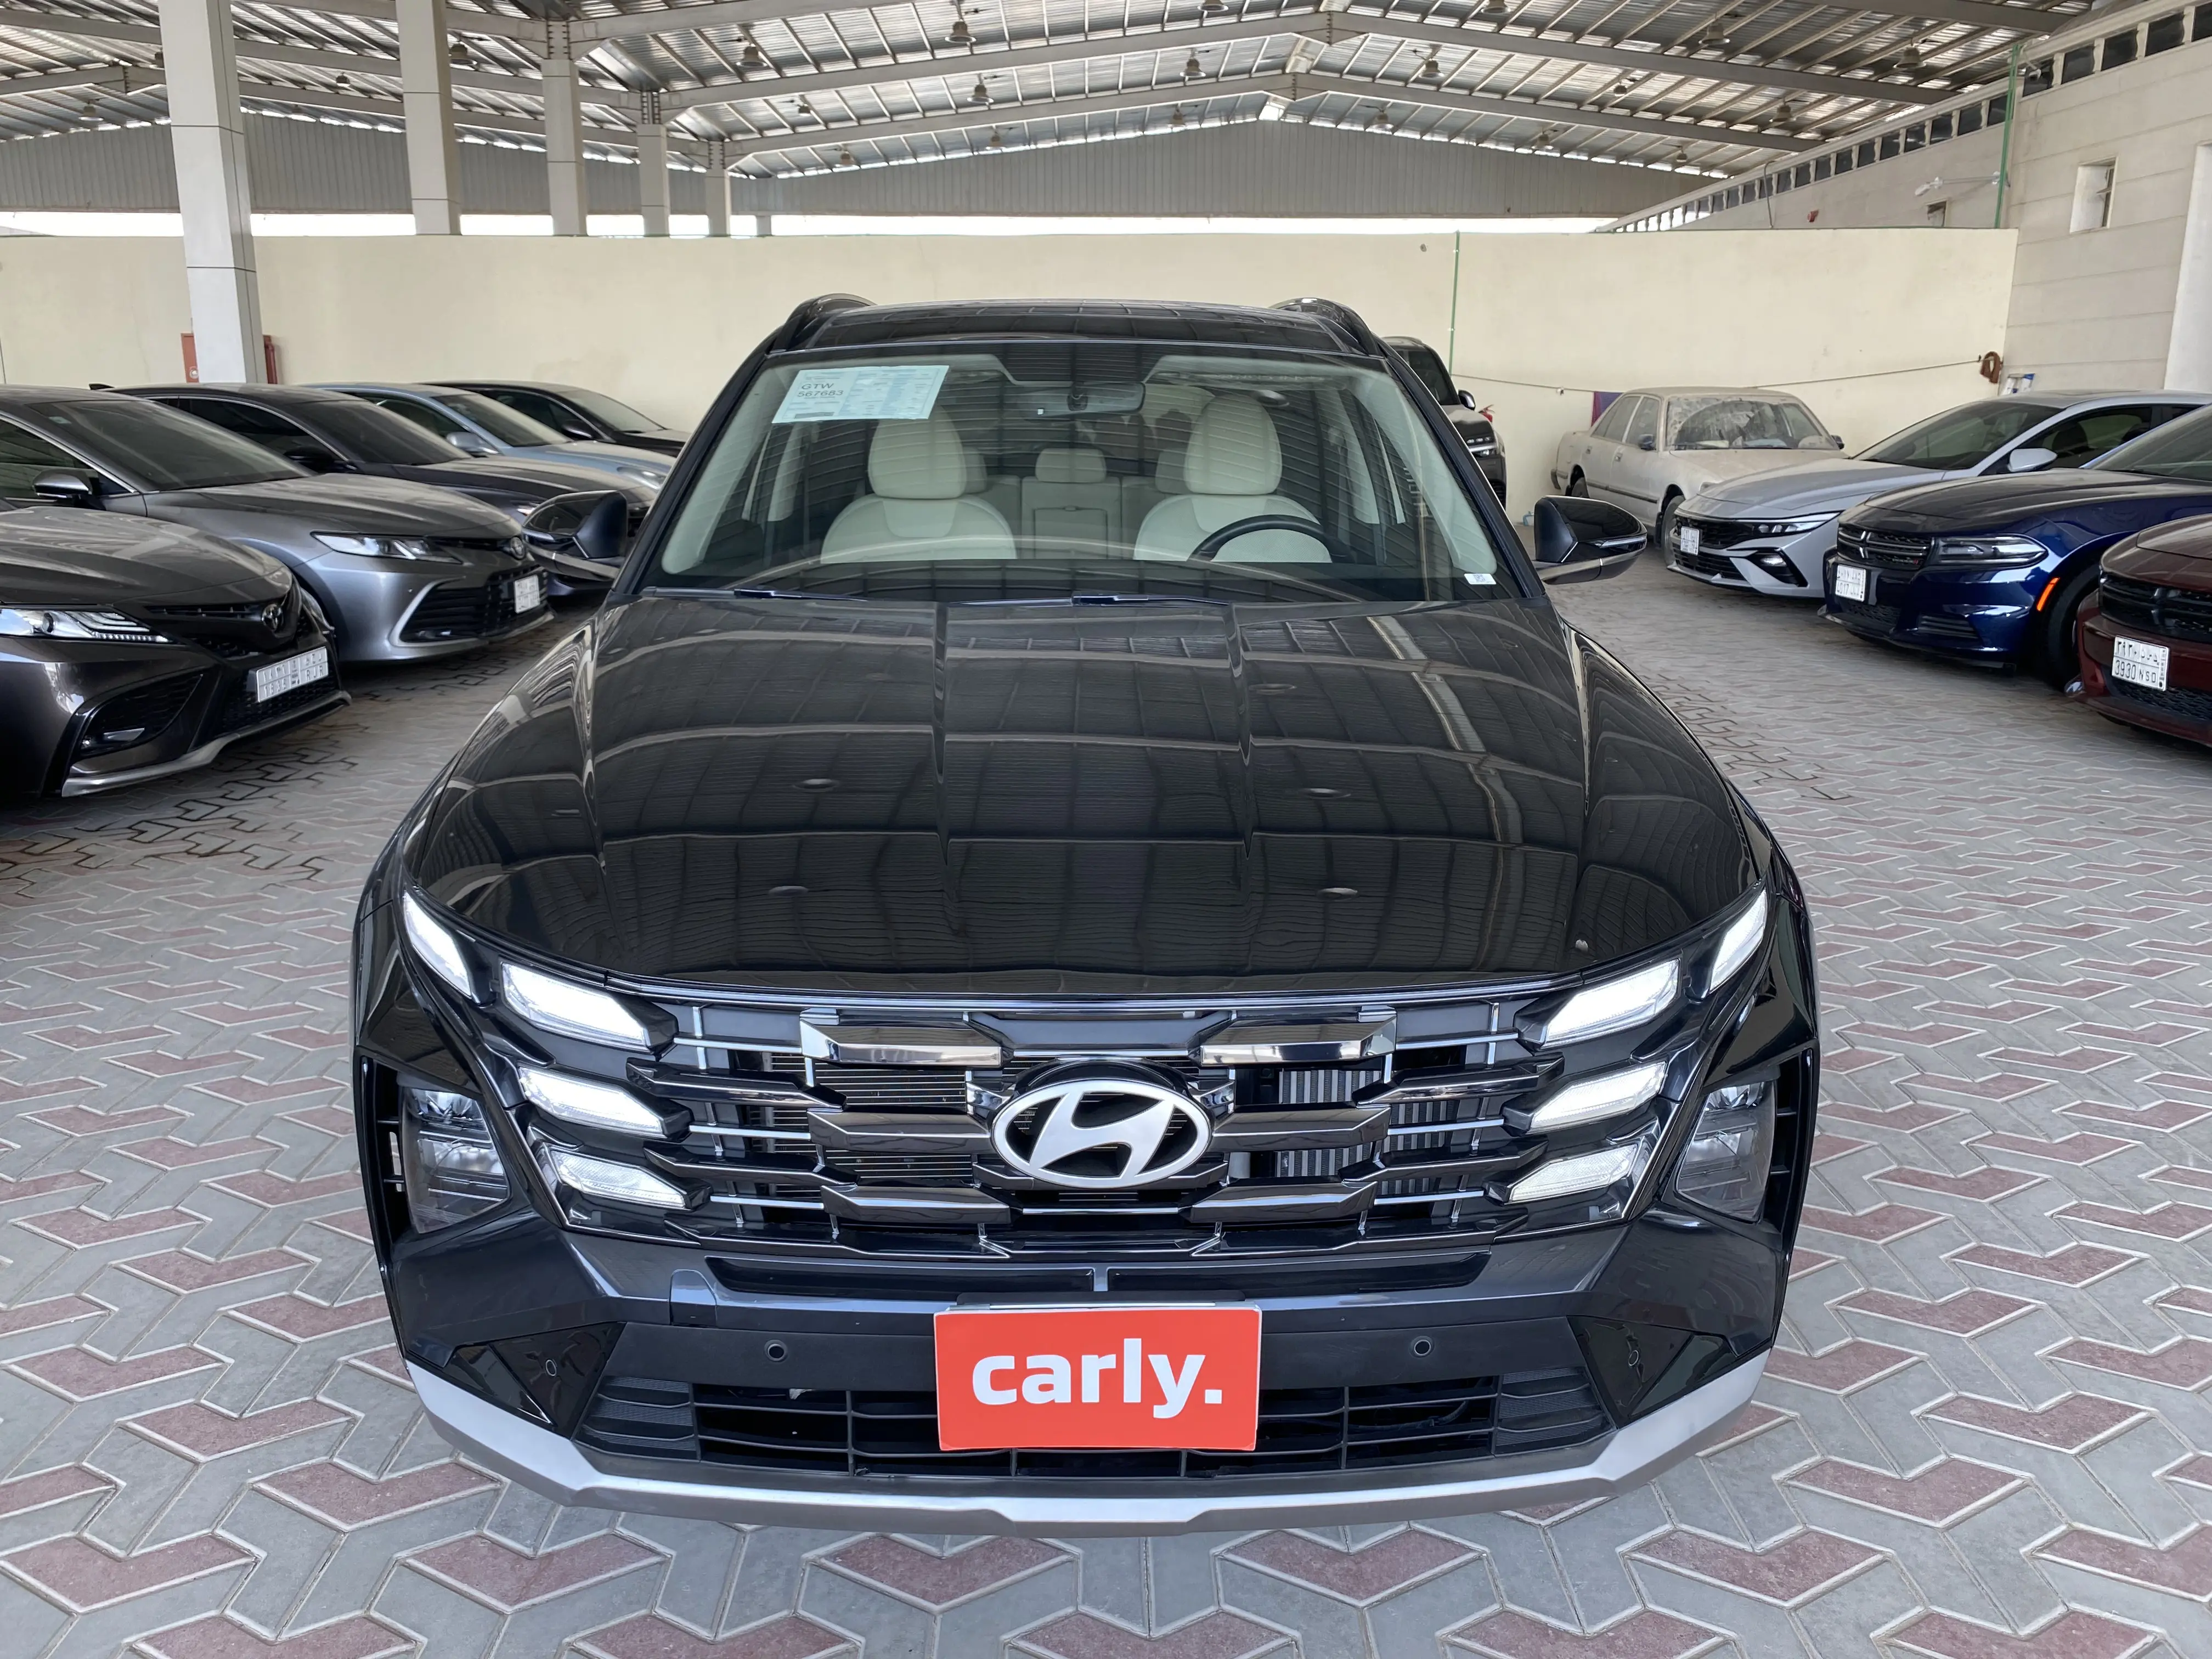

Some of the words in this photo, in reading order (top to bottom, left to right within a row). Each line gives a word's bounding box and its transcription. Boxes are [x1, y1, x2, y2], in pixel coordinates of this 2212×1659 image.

[306, 665, 324, 681] RJR
[2115, 659, 2137, 680] 3930
[2139, 668, 2157, 683] NSD
[973, 1338, 1222, 1419] carly.
